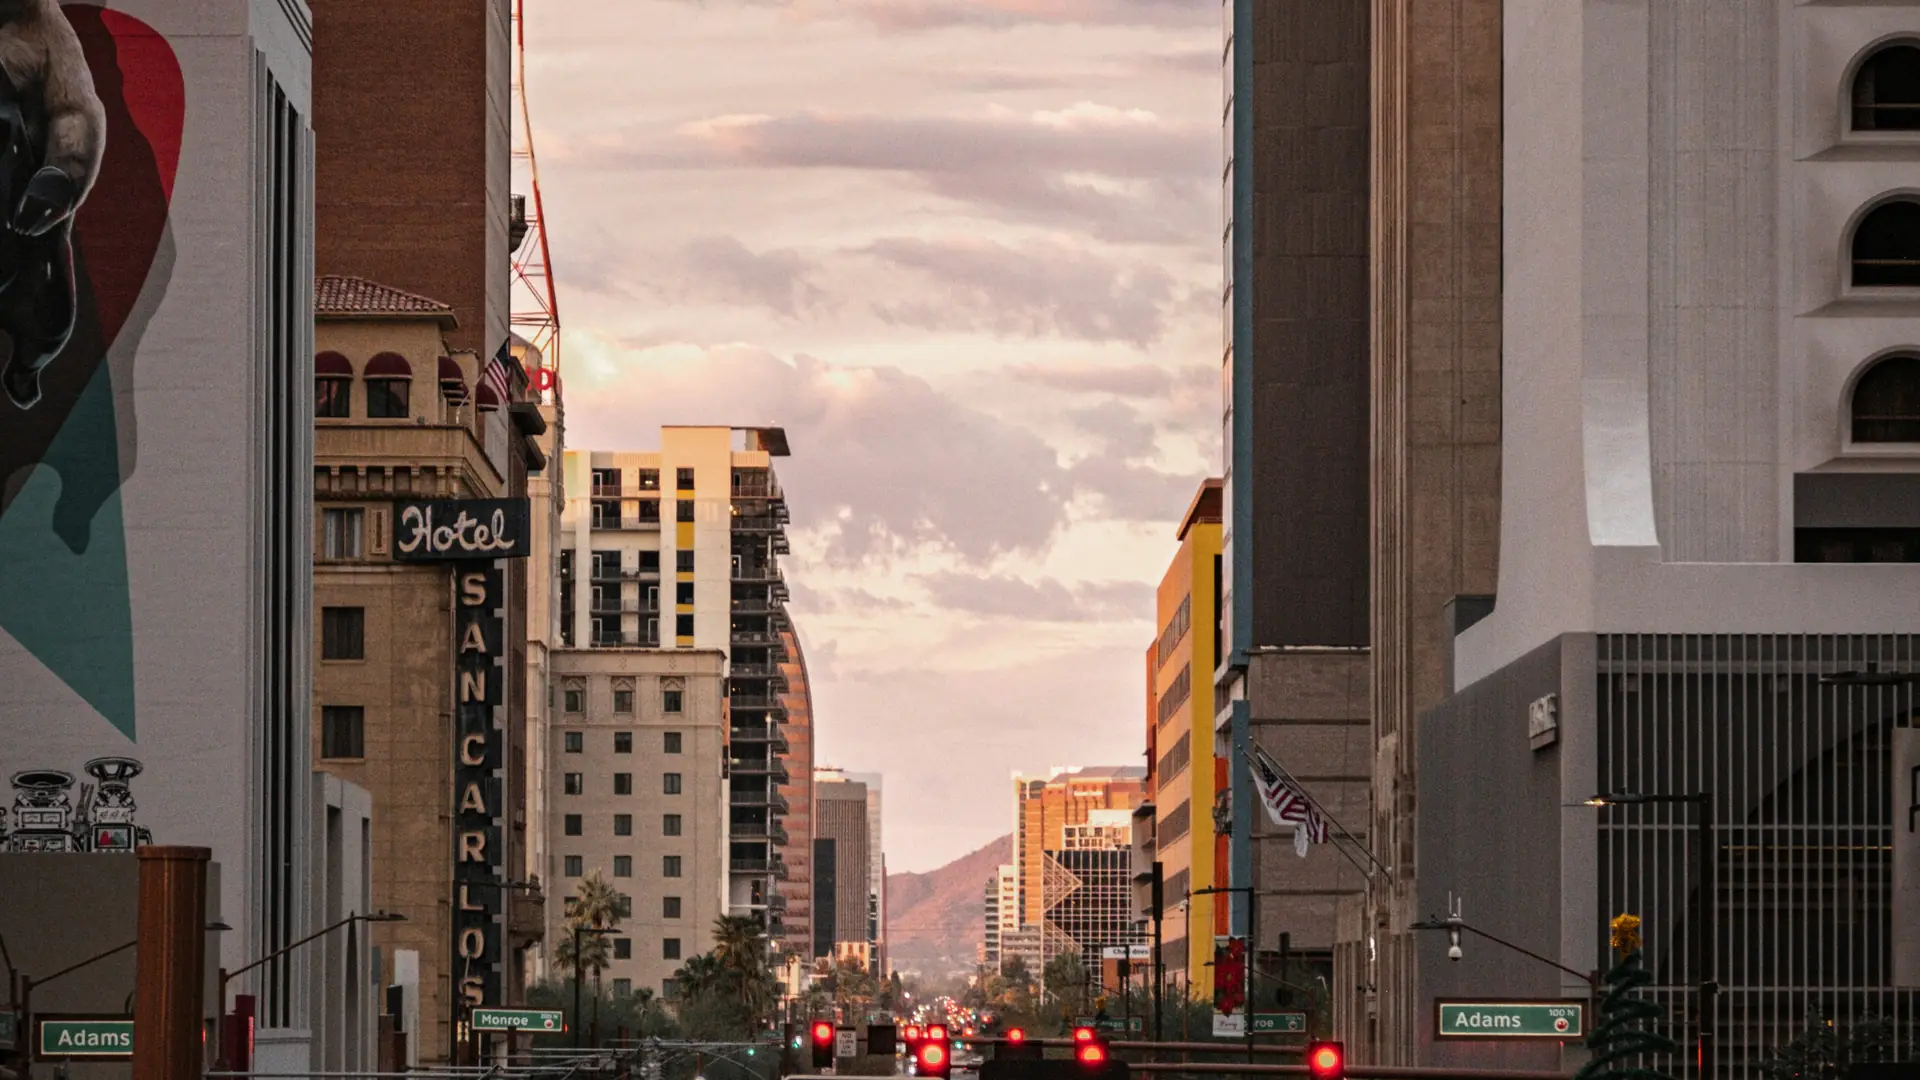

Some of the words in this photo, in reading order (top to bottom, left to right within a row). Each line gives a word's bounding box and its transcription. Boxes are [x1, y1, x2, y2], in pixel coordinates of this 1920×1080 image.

[398, 505, 515, 552] Hotel
[461, 572, 487, 702] SAN
[459, 733, 486, 1007] CARLOS
[481, 1014, 529, 1026] Monroe
[1455, 1011, 1522, 1028] Adams
[1549, 1008, 1565, 1017] 100
[1567, 1008, 1575, 1017] N
[58, 1029, 130, 1047] Adams
